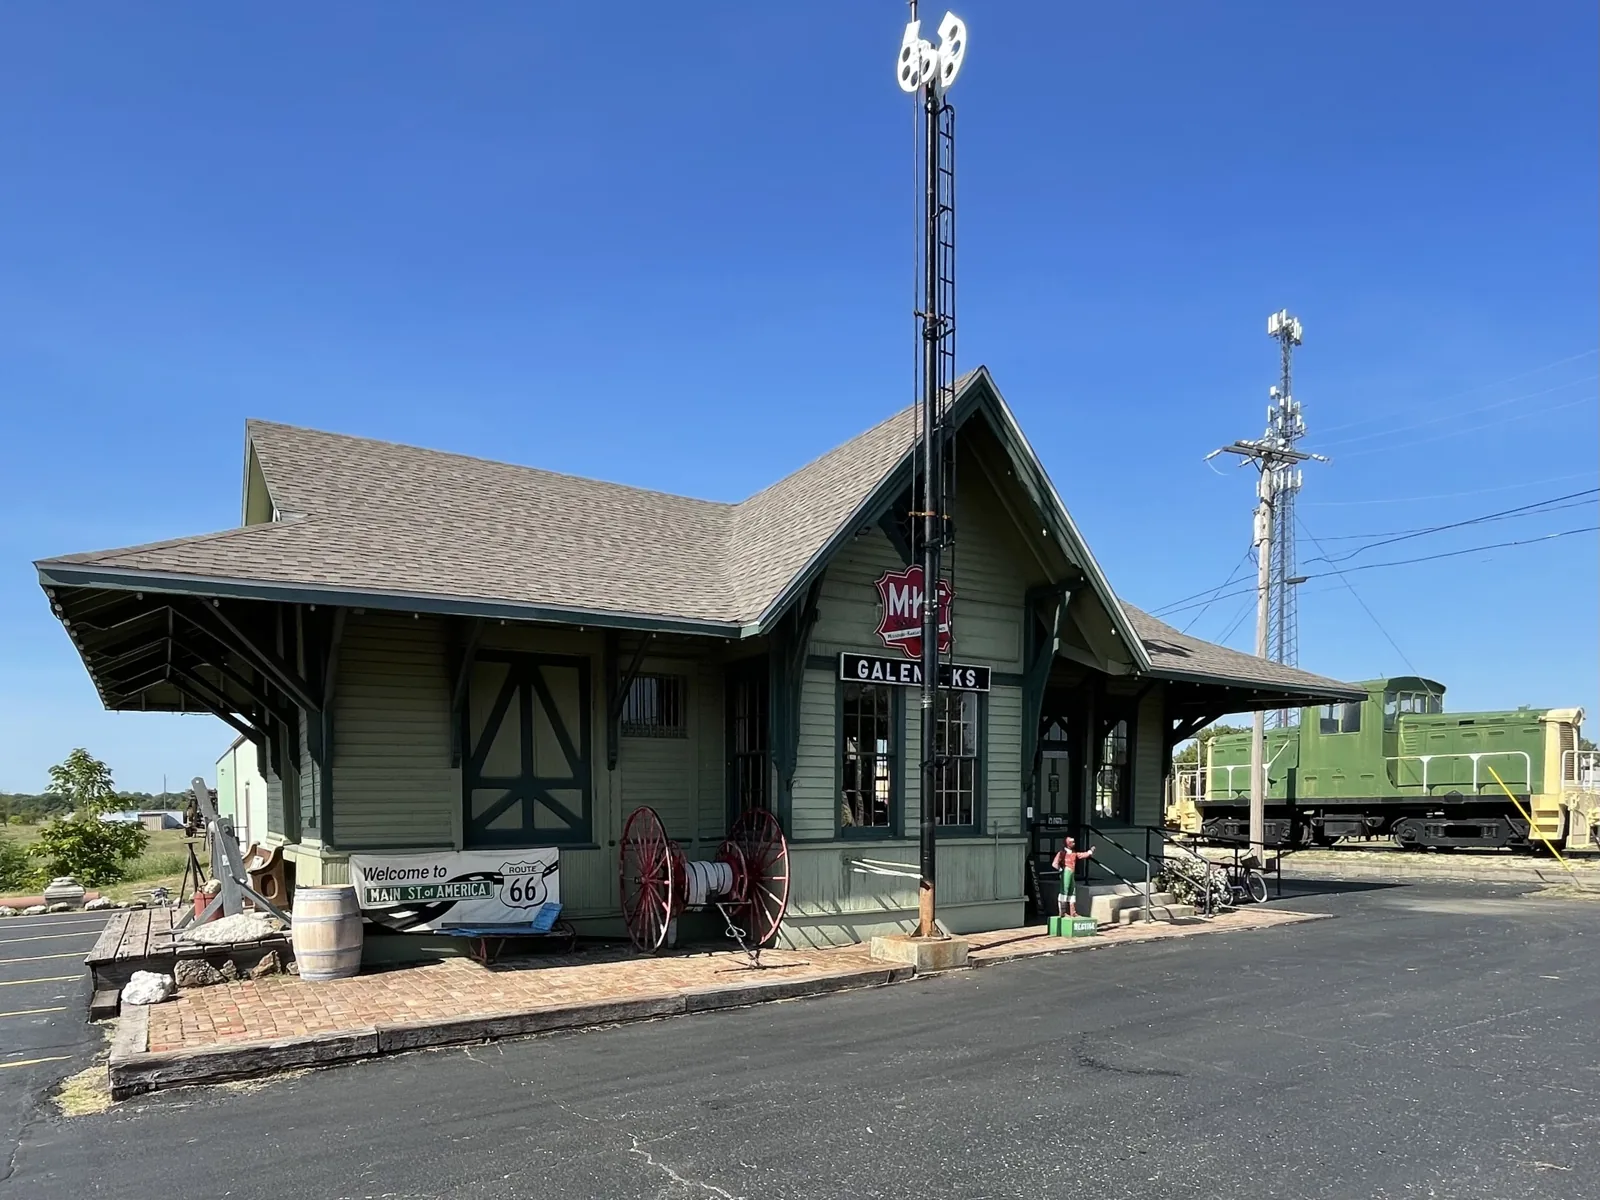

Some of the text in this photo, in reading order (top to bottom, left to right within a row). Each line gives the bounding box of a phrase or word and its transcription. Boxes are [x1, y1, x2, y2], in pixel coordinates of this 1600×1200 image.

[857, 659, 922, 684] GALEN
[363, 865, 447, 882] Welcome to
[508, 865, 537, 874] ROUTE
[370, 887, 401, 902] MAIN
[436, 883, 486, 899] AMERICA
[509, 876, 537, 902] 66
